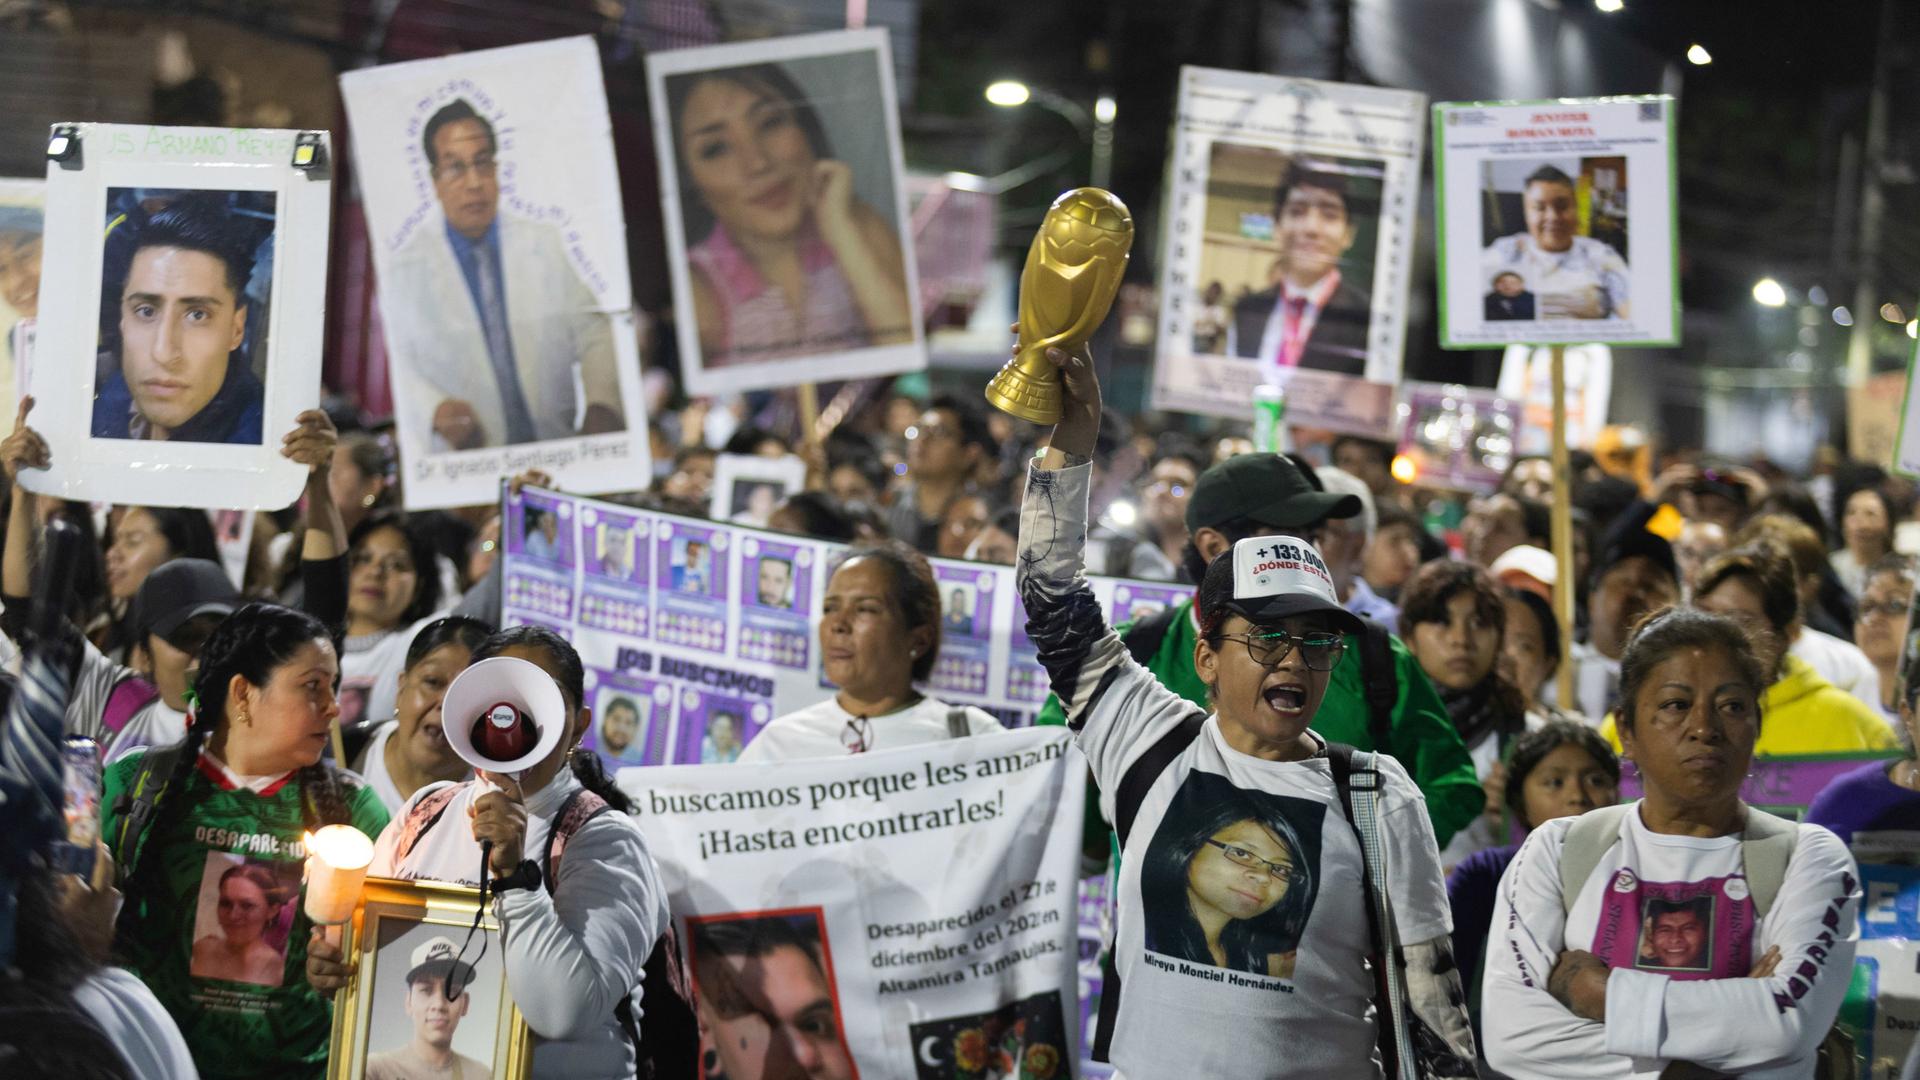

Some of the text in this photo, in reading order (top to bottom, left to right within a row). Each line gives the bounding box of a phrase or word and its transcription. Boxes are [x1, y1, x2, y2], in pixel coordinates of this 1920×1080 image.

[659, 655, 775, 698] BUSCAMOS
[651, 786, 801, 815] buscamos
[809, 771, 917, 809] porque
[924, 761, 968, 788] les
[195, 825, 306, 860] DESAPARECID
[700, 790, 1003, 859] ¡Hasta encontrarles!
[868, 903, 996, 939] Desaparecido
[1001, 890, 1017, 910] el
[1021, 881, 1041, 901] 27
[871, 941, 969, 969] diciembre
[974, 924, 1004, 951] del
[879, 969, 965, 995] Altamira
[1144, 954, 1295, 994] Mireya Montiel Hernández
